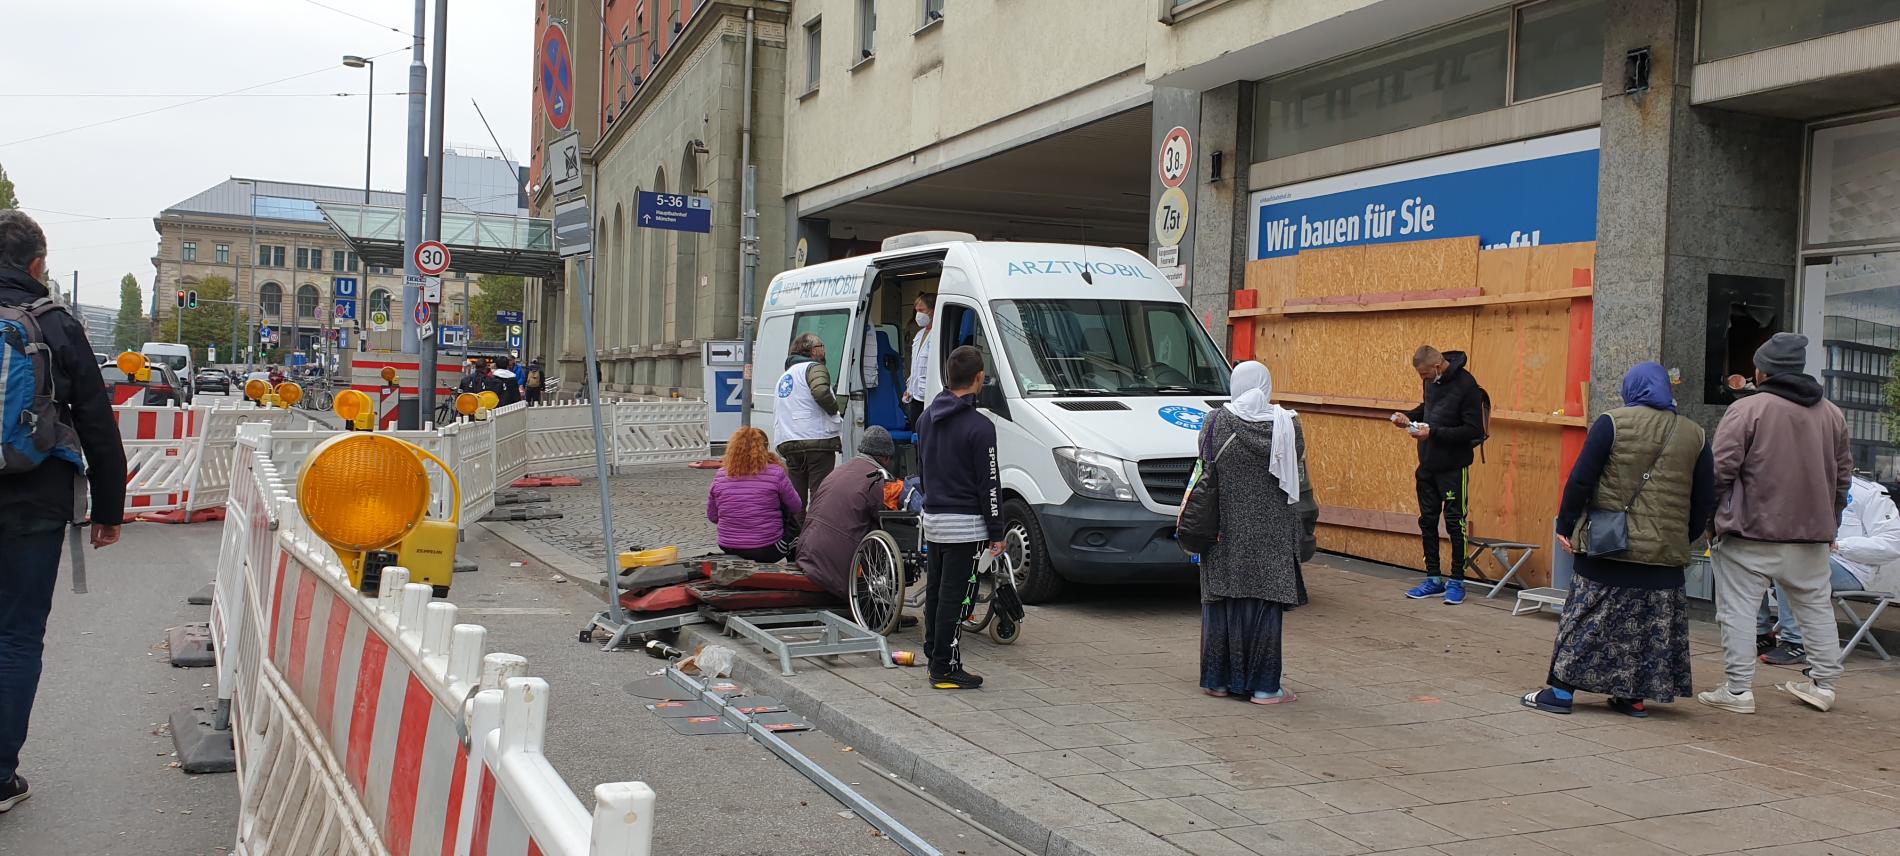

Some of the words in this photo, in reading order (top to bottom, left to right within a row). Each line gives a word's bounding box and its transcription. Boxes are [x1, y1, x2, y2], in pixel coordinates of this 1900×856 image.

[657, 194, 683, 208] 5-36
[1162, 205, 1181, 233] 7,5t
[1266, 218, 1297, 252] Wir
[1300, 215, 1360, 248] bauen
[1364, 203, 1396, 240] für
[1399, 196, 1435, 236] Sie
[422, 250, 442, 265] 30
[1008, 260, 1152, 280] ARZTMOBIL
[340, 280, 353, 294] U
[799, 274, 858, 298] ARZTMOBIL
[511, 325, 521, 335] S
[512, 337, 520, 347] U
[1175, 420, 1197, 429] DER
[988, 447, 997, 481] SPORT
[989, 487, 999, 517] WEAR
